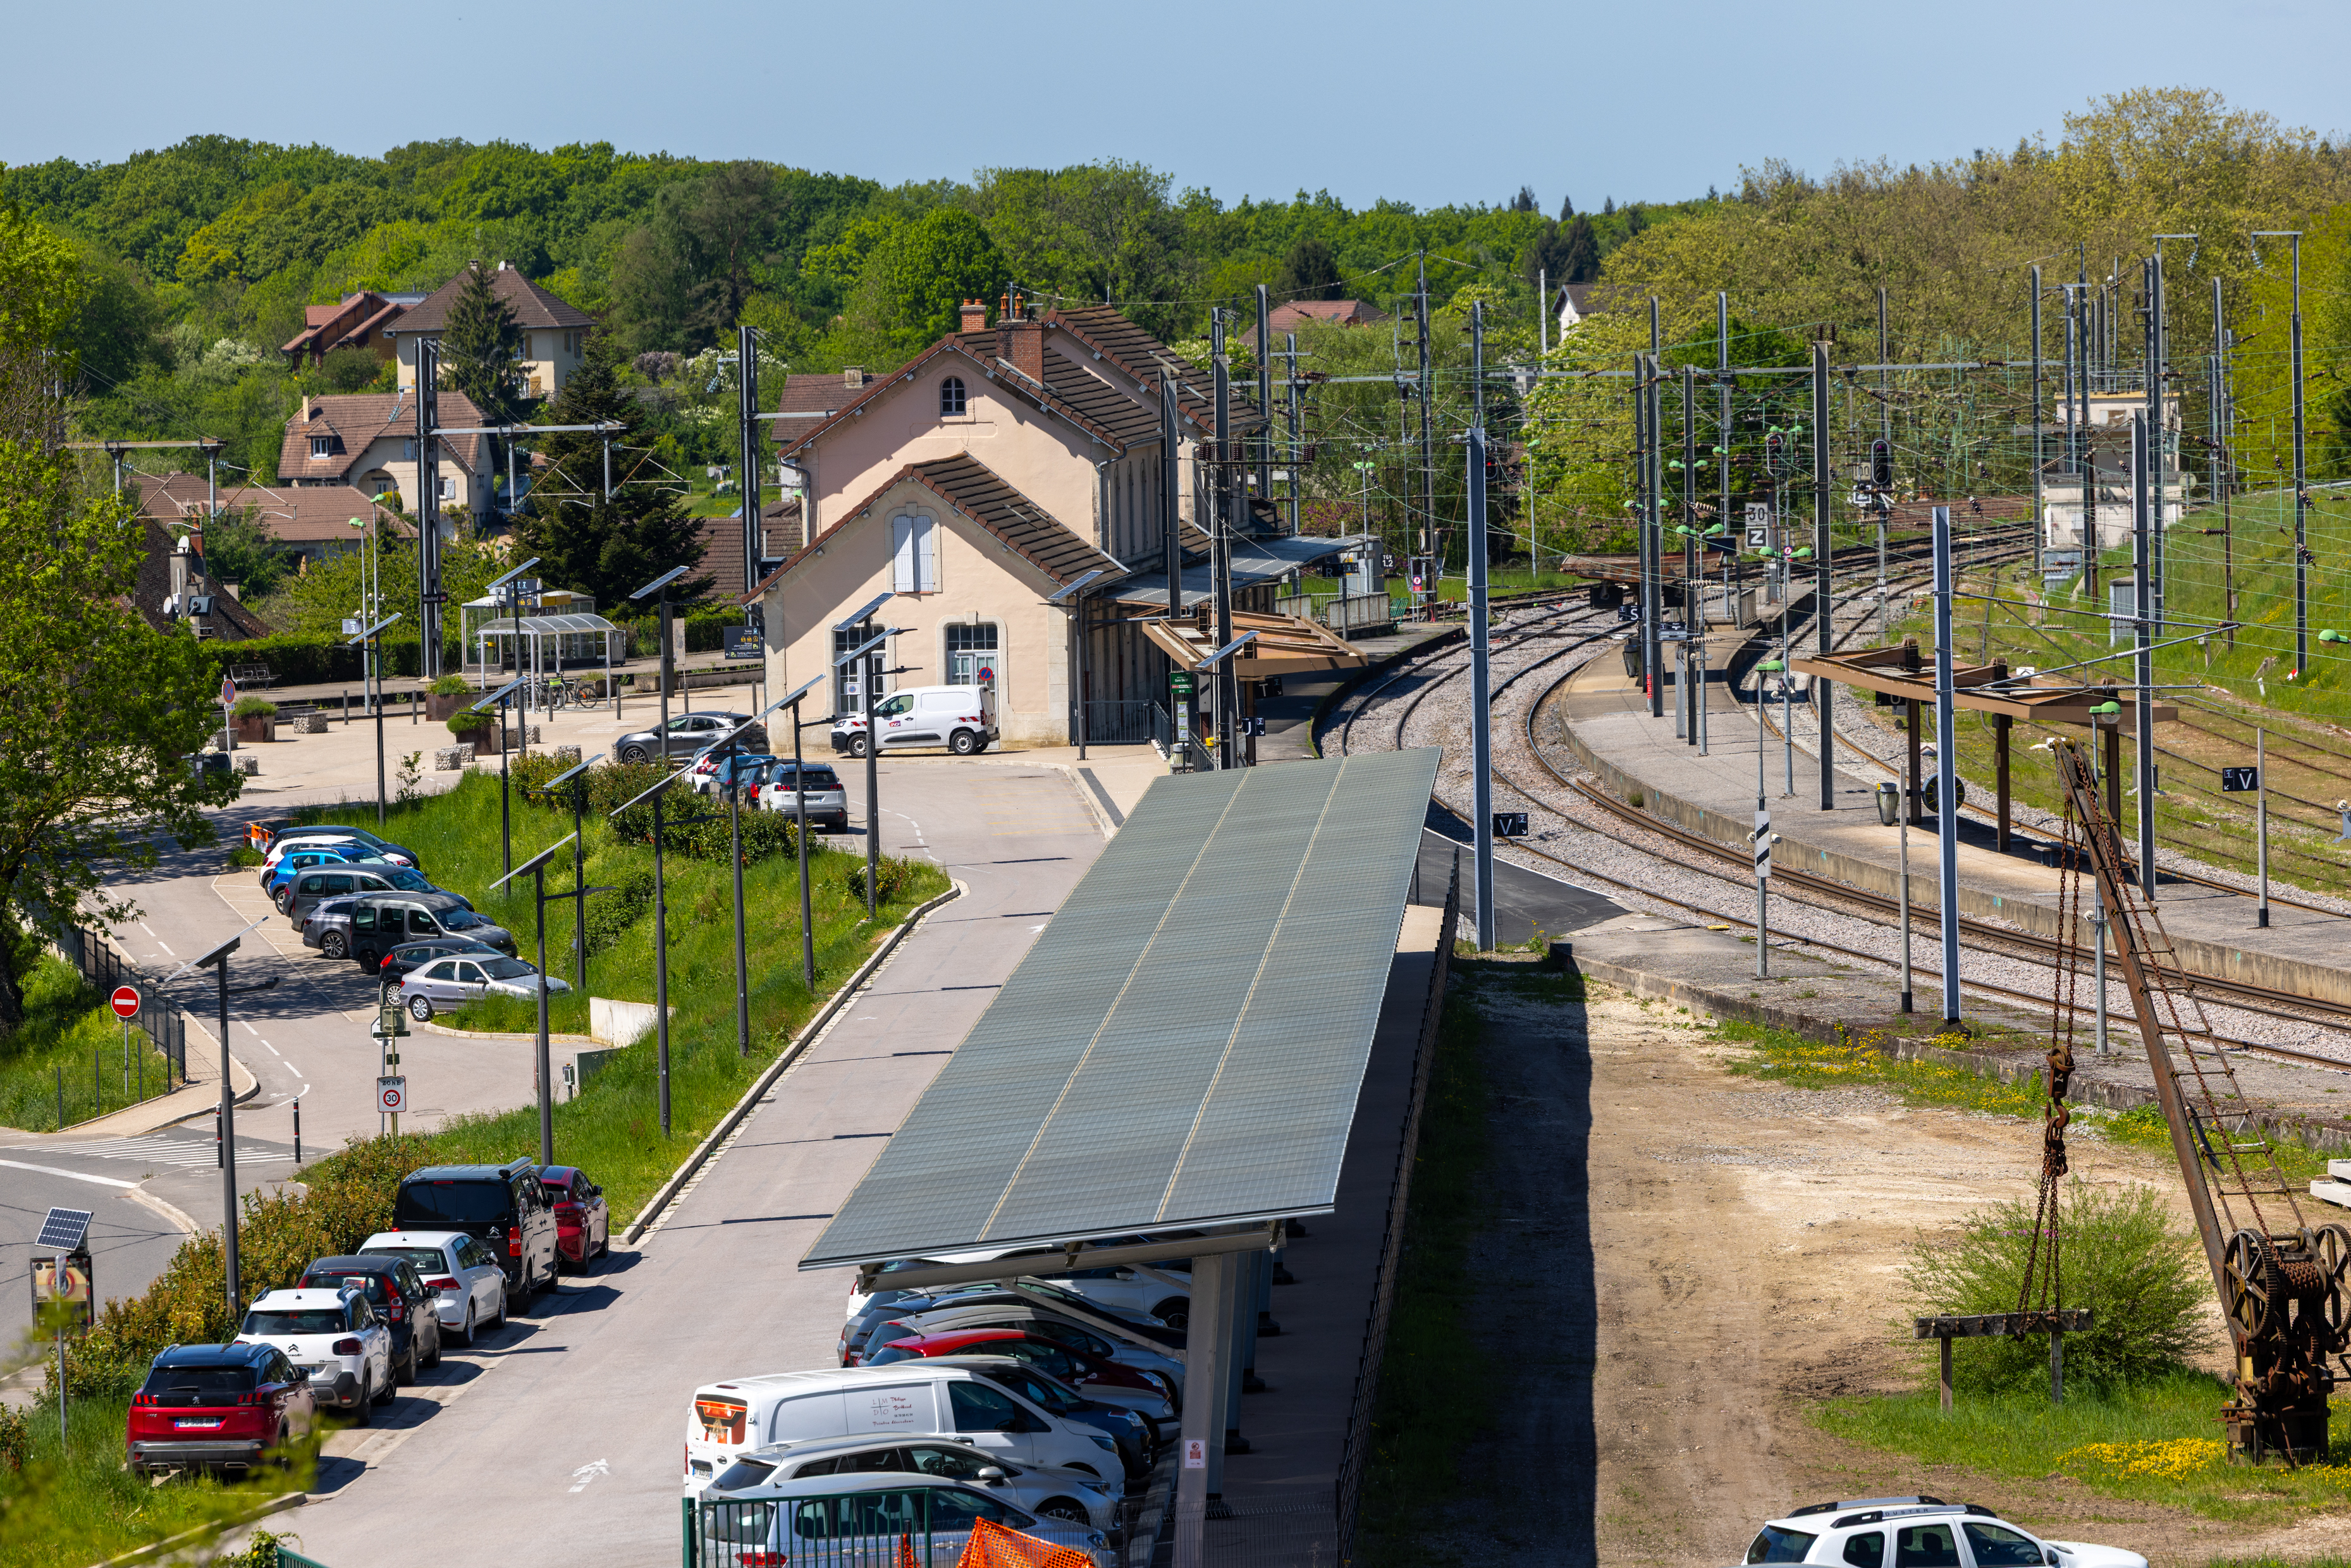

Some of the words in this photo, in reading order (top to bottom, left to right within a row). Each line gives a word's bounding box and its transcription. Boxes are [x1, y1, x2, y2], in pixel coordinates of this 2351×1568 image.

[1748, 507, 1765, 520] 30
[1750, 530, 1764, 544] Z
[1326, 568, 1333, 577] R
[1630, 608, 1638, 620] S
[1258, 683, 1268, 697] T
[2239, 773, 2252, 790] V
[1499, 819, 1513, 835] V
[1885, 1508, 1929, 1516] DUSTER
